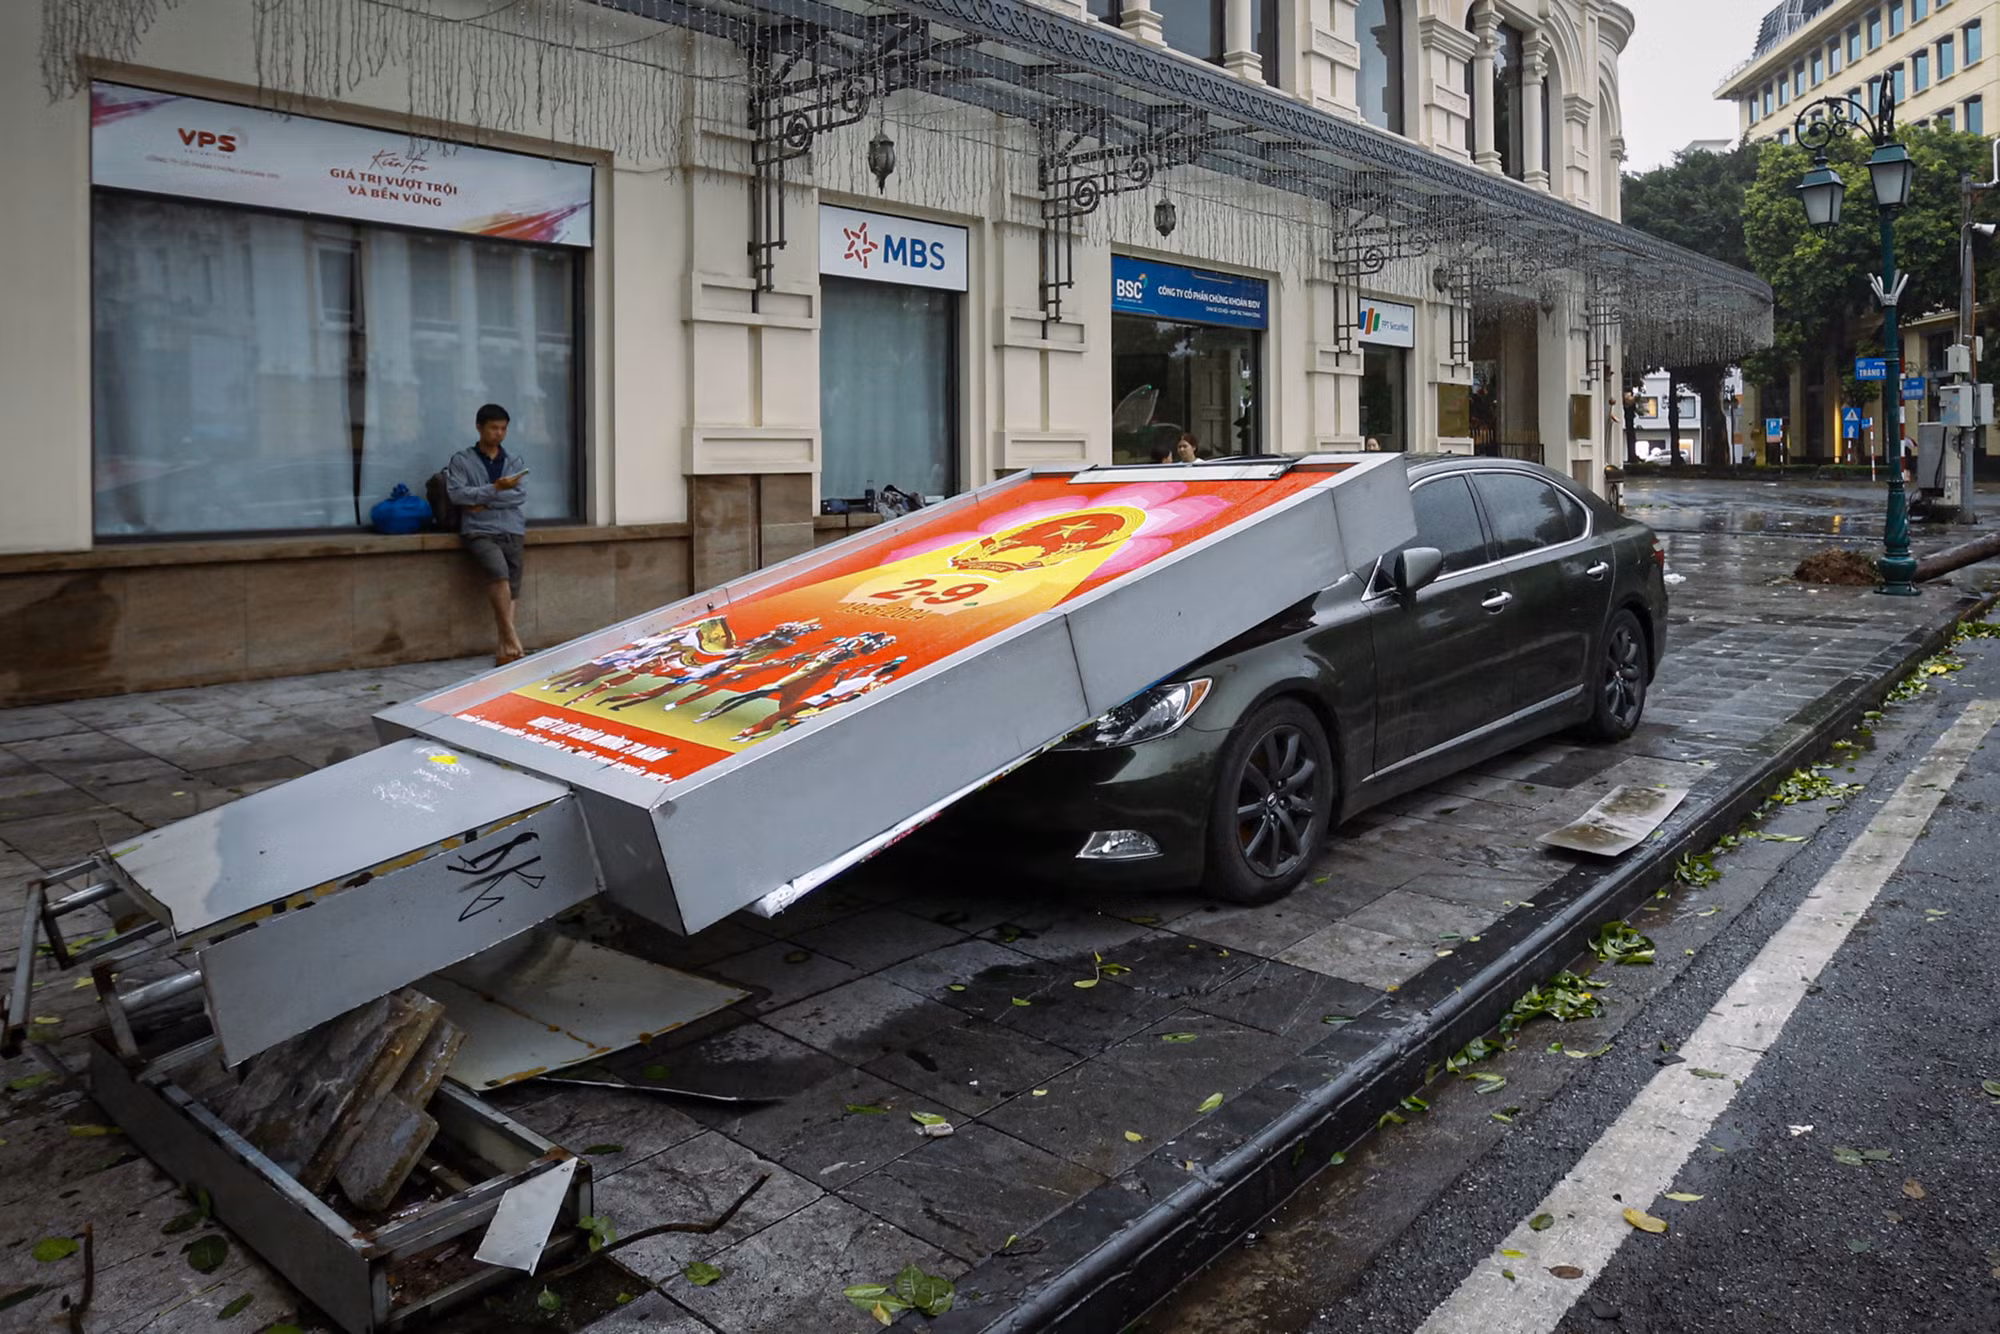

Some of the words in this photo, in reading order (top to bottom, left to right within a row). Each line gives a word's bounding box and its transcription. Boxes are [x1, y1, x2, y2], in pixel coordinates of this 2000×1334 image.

[178, 128, 236, 152] VPS
[330, 168, 356, 181] GIÁ
[359, 172, 382, 186] TRỊ
[385, 176, 422, 190] VƯỢT
[426, 182, 458, 195] TRỘI
[348, 184, 367, 196] VÀ
[402, 192, 442, 206] VỮNG
[883, 234, 945, 271] MBS
[1116, 278, 1142, 298] BSC
[1176, 288, 1184, 298] TY
[1770, 421, 1777, 429] P
